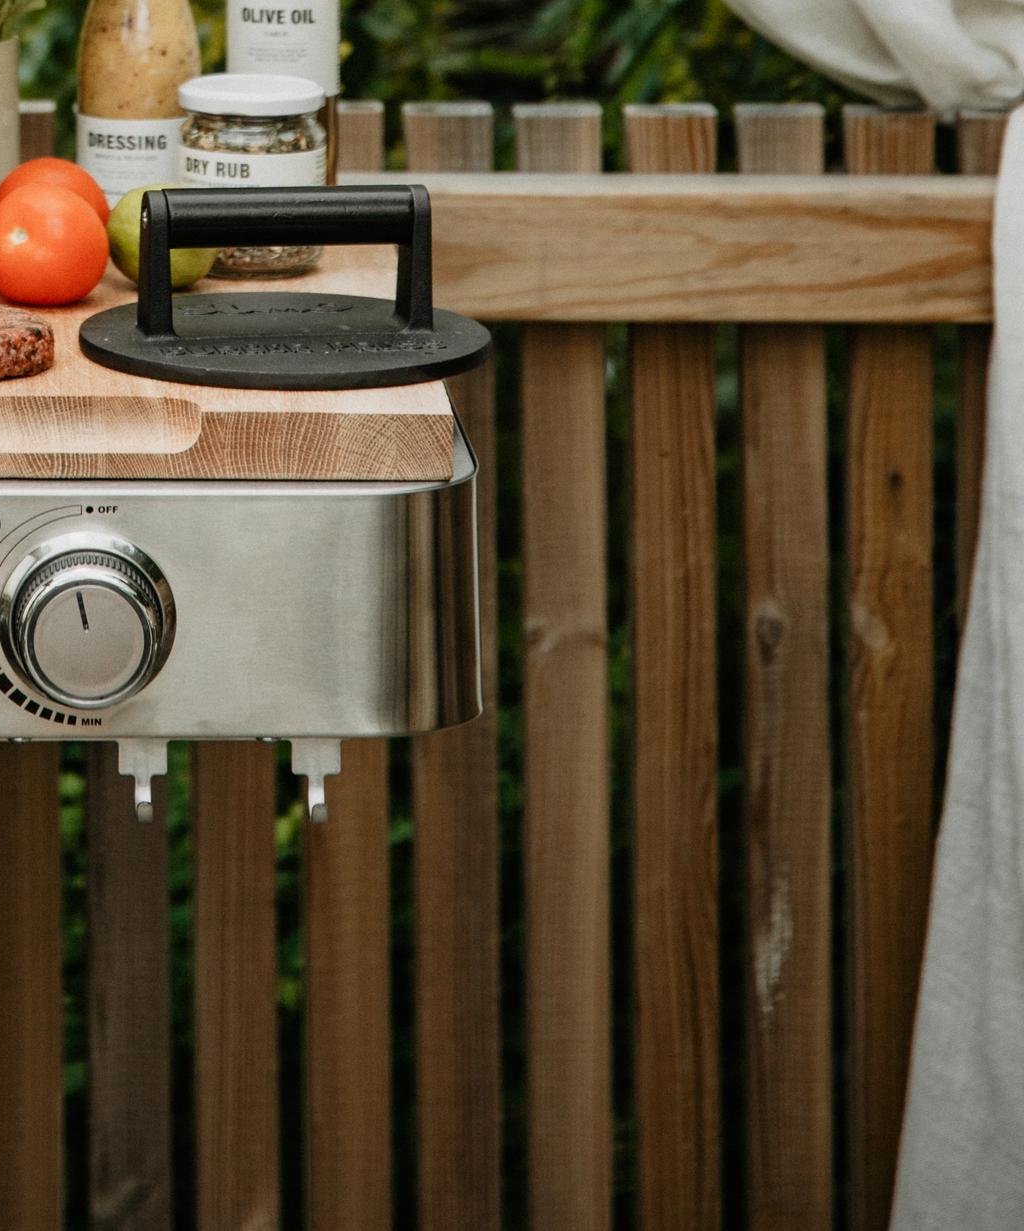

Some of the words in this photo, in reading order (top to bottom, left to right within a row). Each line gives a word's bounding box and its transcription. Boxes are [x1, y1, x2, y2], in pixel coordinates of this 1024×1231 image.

[242, 8, 286, 24] OLIVE
[291, 9, 316, 24] OIL
[88, 132, 167, 150] DRESSING
[186, 157, 208, 176] DRY
[216, 162, 250, 178] RUB
[81, 718, 102, 726] MIN
